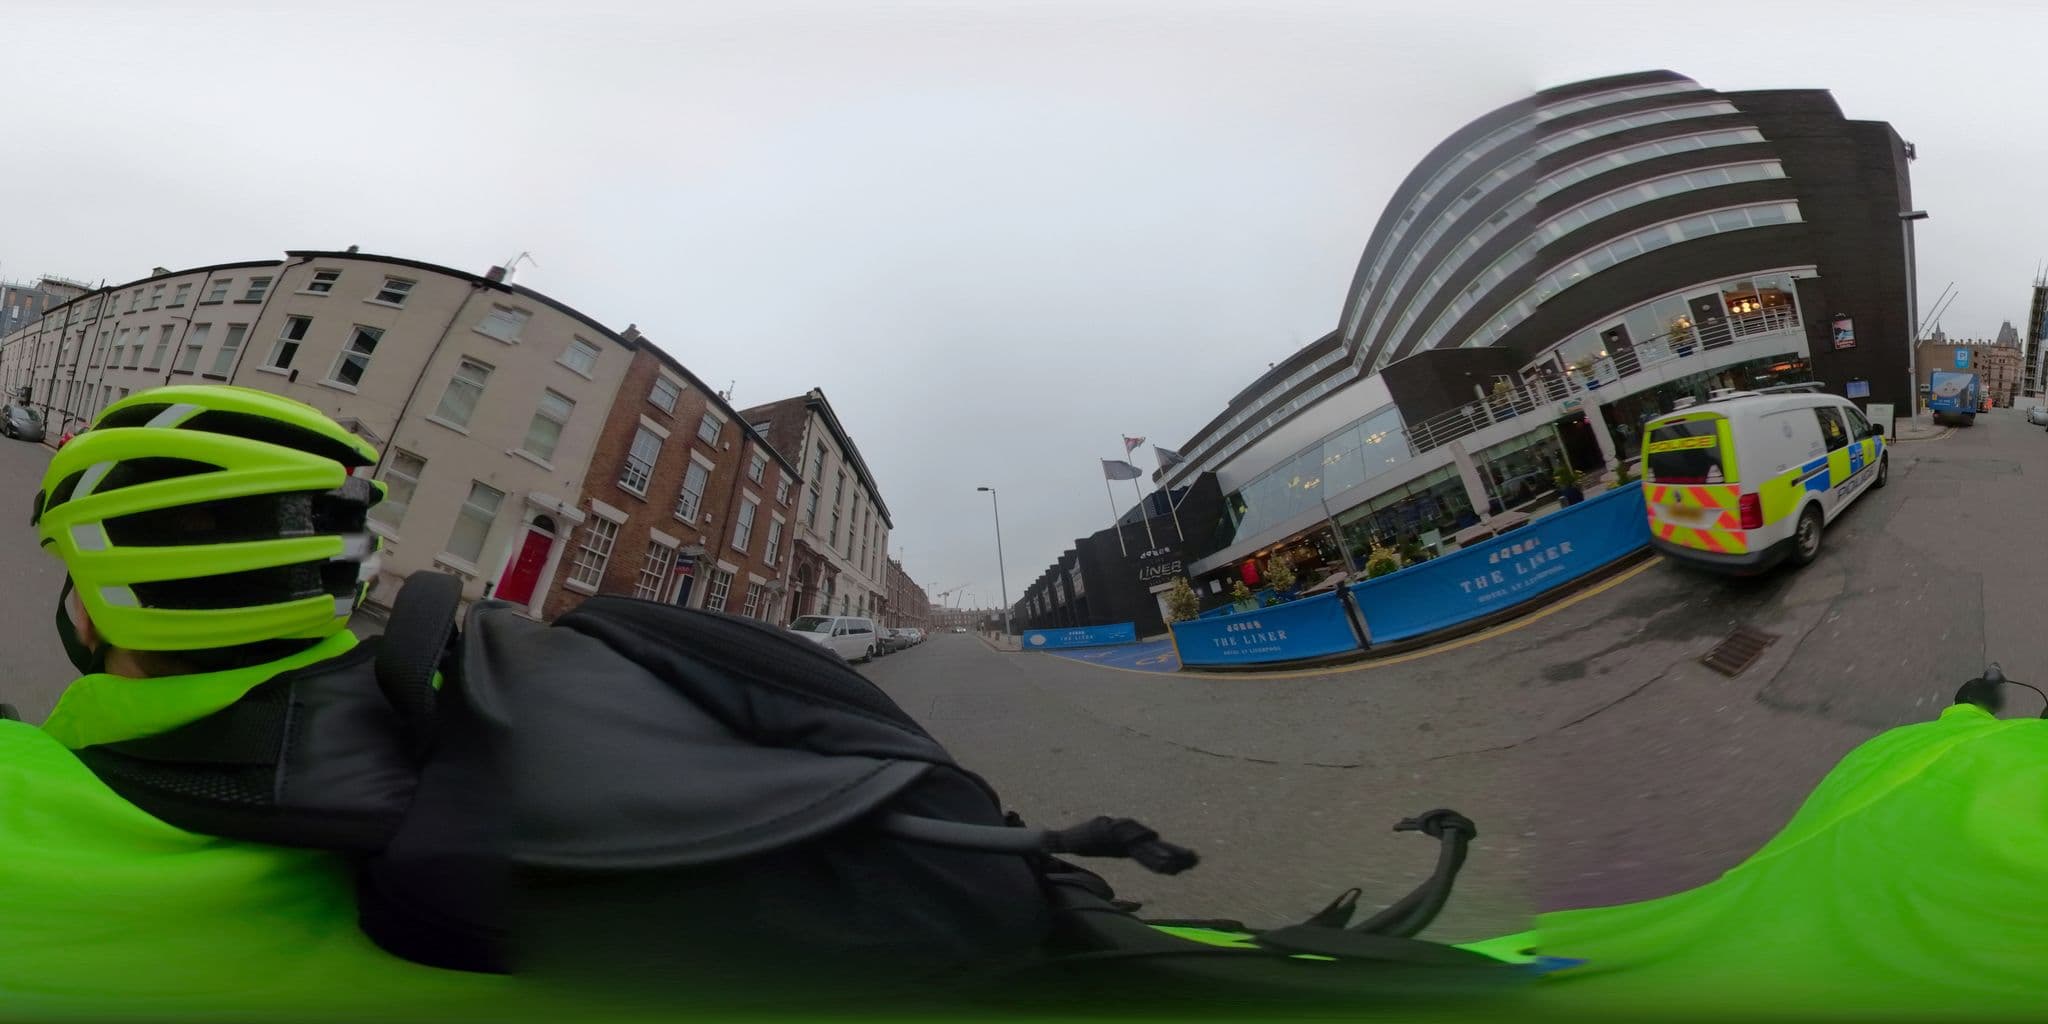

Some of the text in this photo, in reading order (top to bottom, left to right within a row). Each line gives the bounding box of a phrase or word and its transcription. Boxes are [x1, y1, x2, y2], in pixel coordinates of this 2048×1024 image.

[1649, 437, 1712, 452] POLICE
[1837, 467, 1875, 501] POLICE
[1461, 541, 1574, 593] THE LINER
[1213, 630, 1288, 647] THE LINER
